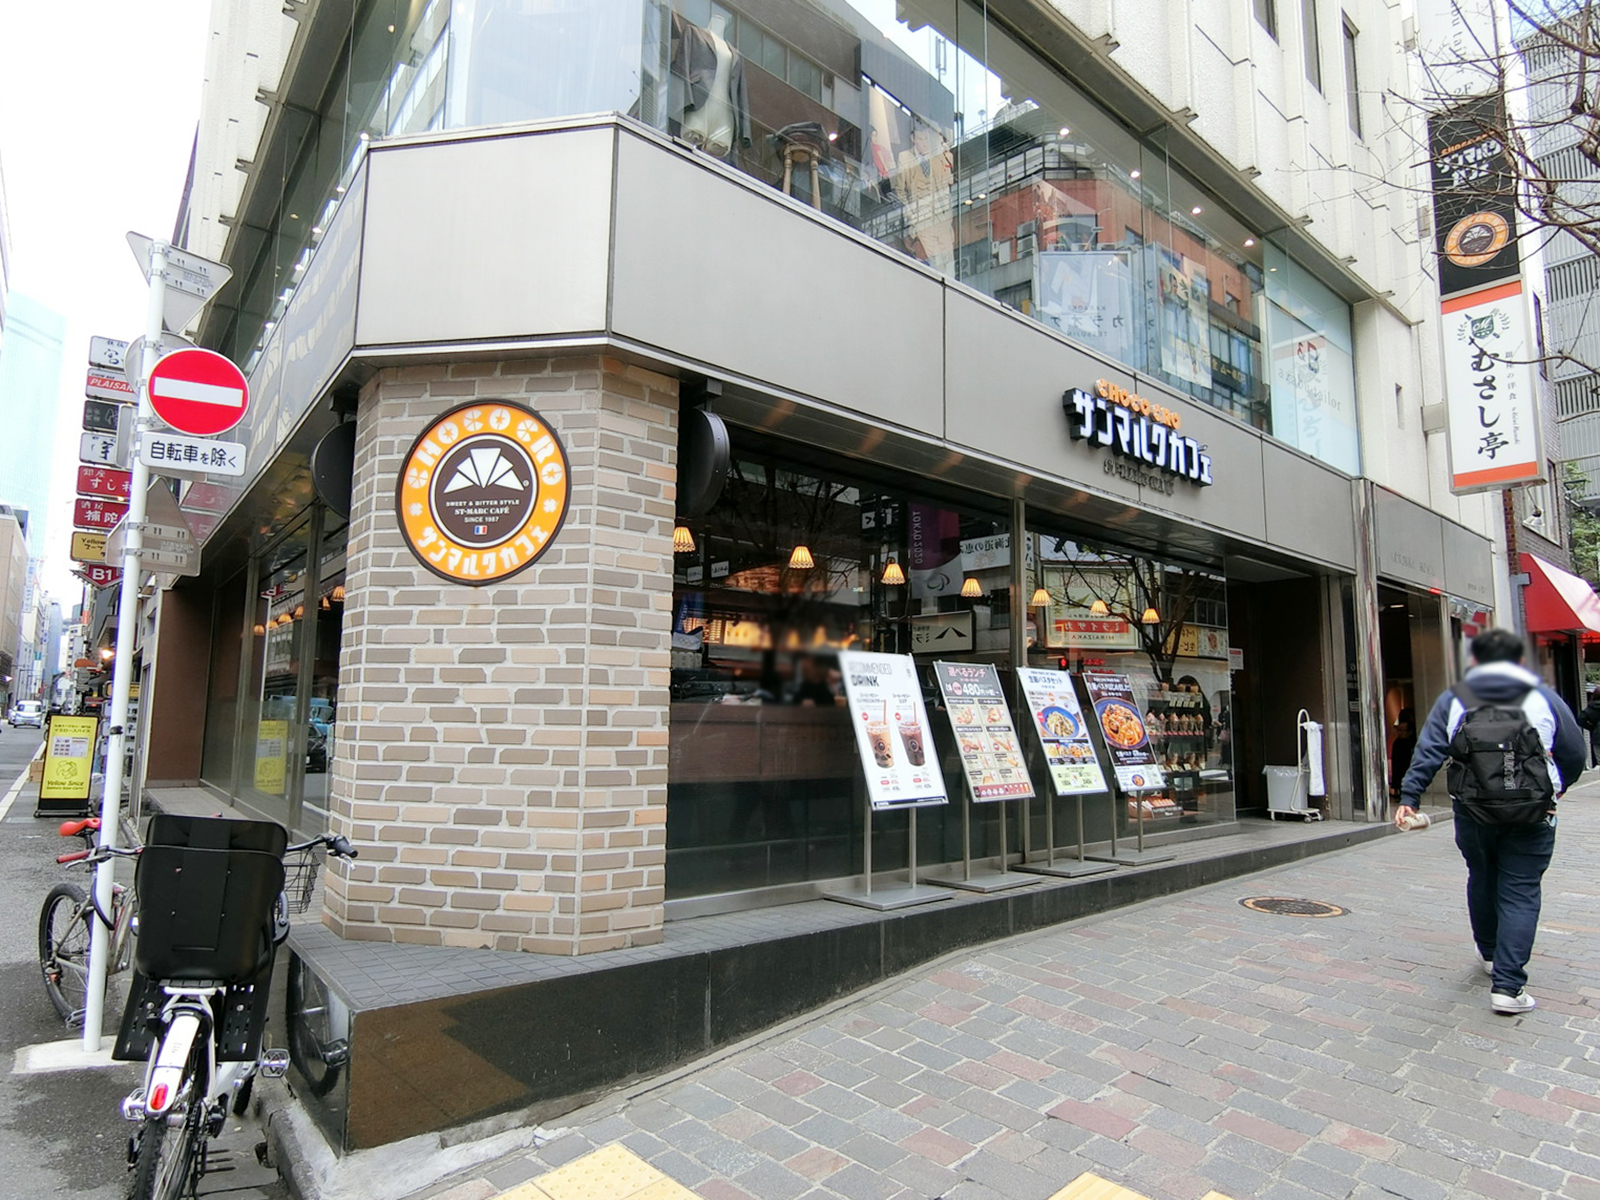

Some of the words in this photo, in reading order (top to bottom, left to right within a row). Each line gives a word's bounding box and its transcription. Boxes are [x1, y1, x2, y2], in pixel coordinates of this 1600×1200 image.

[1095, 378, 1150, 417] CHOCO
[1151, 403, 1181, 430] CRO
[1471, 349, 1509, 460] むさし亭
[150, 440, 237, 468] 自転車を除く
[407, 408, 511, 490] CHOCO
[516, 418, 563, 486] CRO
[1071, 388, 1214, 487] サンマルクカフェ
[454, 507, 489, 516] ST-MARC
[489, 506, 510, 515] CAFÉ
[417, 524, 550, 577] サンマルクカフェ
[92, 568, 112, 580] B1
[851, 674, 880, 687] DRINK
[962, 682, 981, 696] 480
